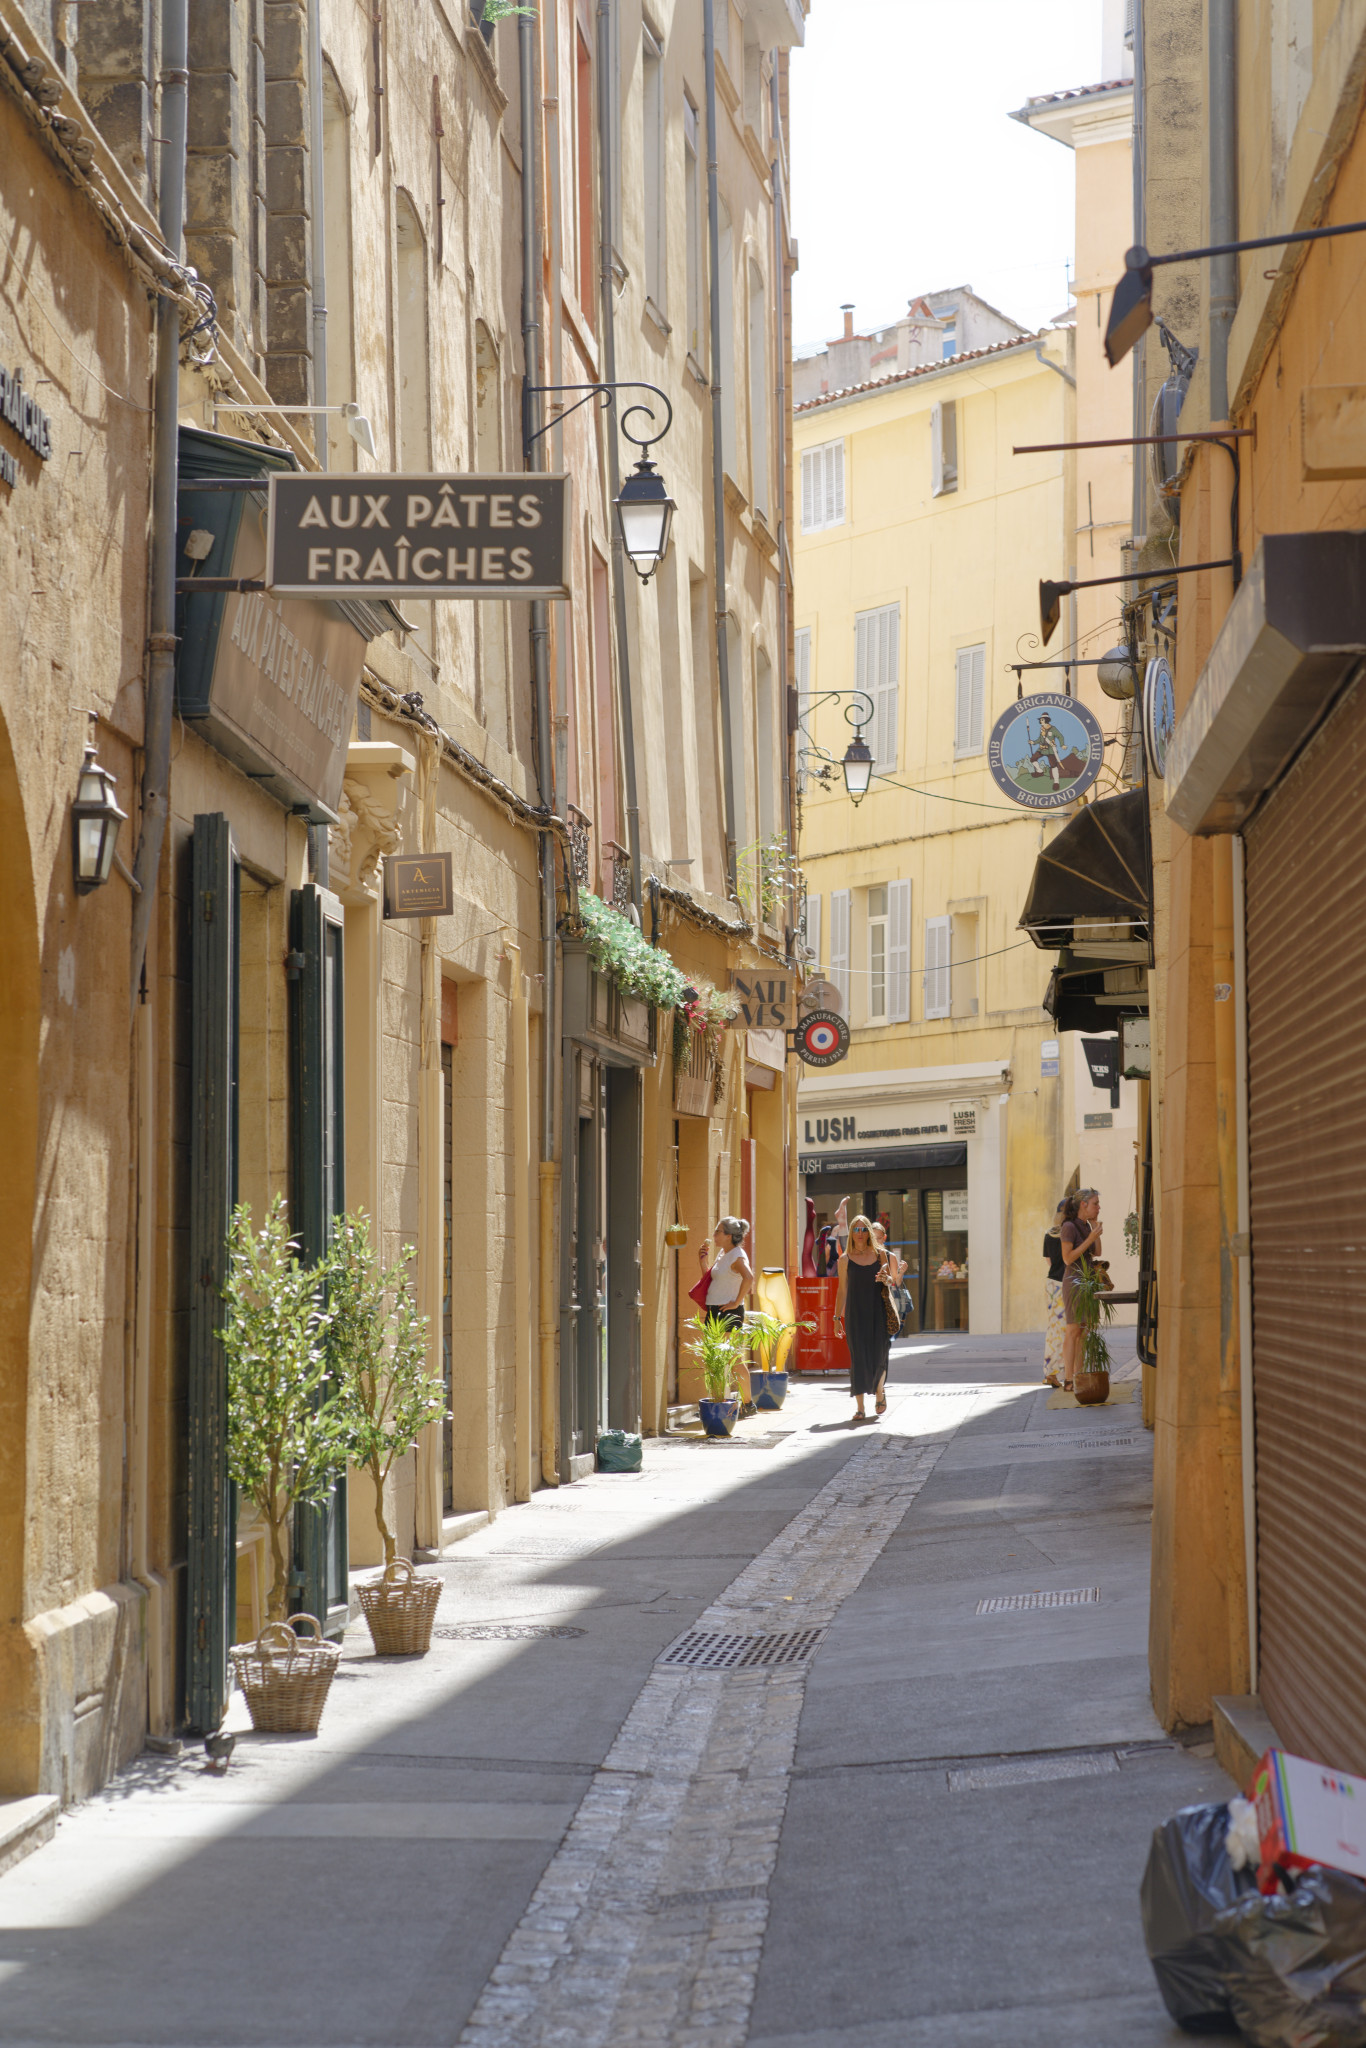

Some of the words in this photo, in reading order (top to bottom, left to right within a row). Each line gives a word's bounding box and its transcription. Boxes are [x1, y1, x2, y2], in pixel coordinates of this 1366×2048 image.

[298, 495, 391, 528] AUX
[406, 482, 543, 528] PÂTES
[307, 535, 535, 581] FRAÎCHES
[230, 592, 264, 666] AUX
[258, 600, 299, 698] PÂTES
[294, 647, 349, 748] FRAÎCHES
[1014, 695, 1073, 713] BRIGAND
[990, 740, 1001, 768] PUB
[1090, 733, 1101, 761] PUB
[1016, 788, 1076, 806] BRIGAND
[801, 1013, 848, 1041] MANUFACTURE
[800, 1048, 827, 1064] PERRIN
[829, 1048, 844, 1061] 1924
[953, 1110, 976, 1119] LUSH
[954, 1118, 976, 1126] FRESH
[805, 1116, 856, 1143] LUSH
